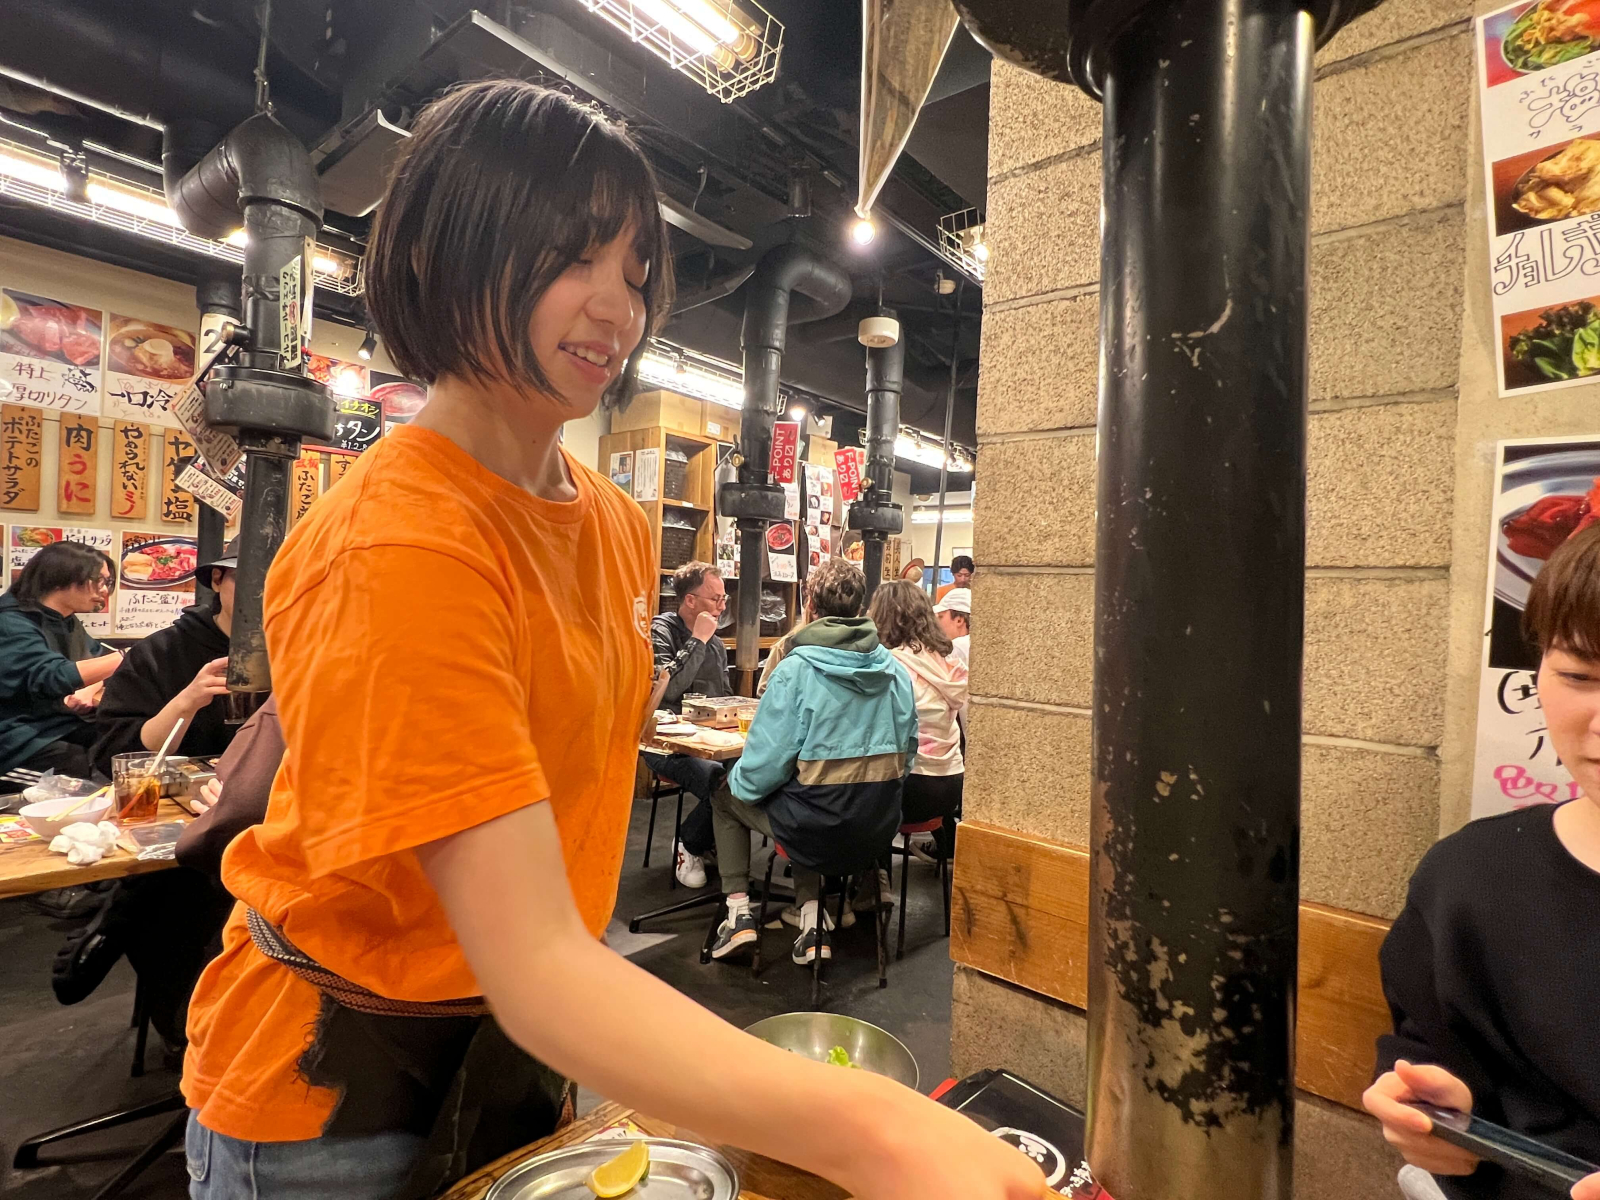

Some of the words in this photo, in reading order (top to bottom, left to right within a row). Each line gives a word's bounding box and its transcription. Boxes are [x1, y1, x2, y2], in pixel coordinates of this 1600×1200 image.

[5, 382, 88, 411] 厚切りタン
[11, 361, 51, 382] 特上
[106, 388, 178, 412] 一口冷
[2, 416, 26, 504] ポテトサラダ
[64, 422, 94, 503] 肉うに
[162, 435, 193, 523] ヤ塩
